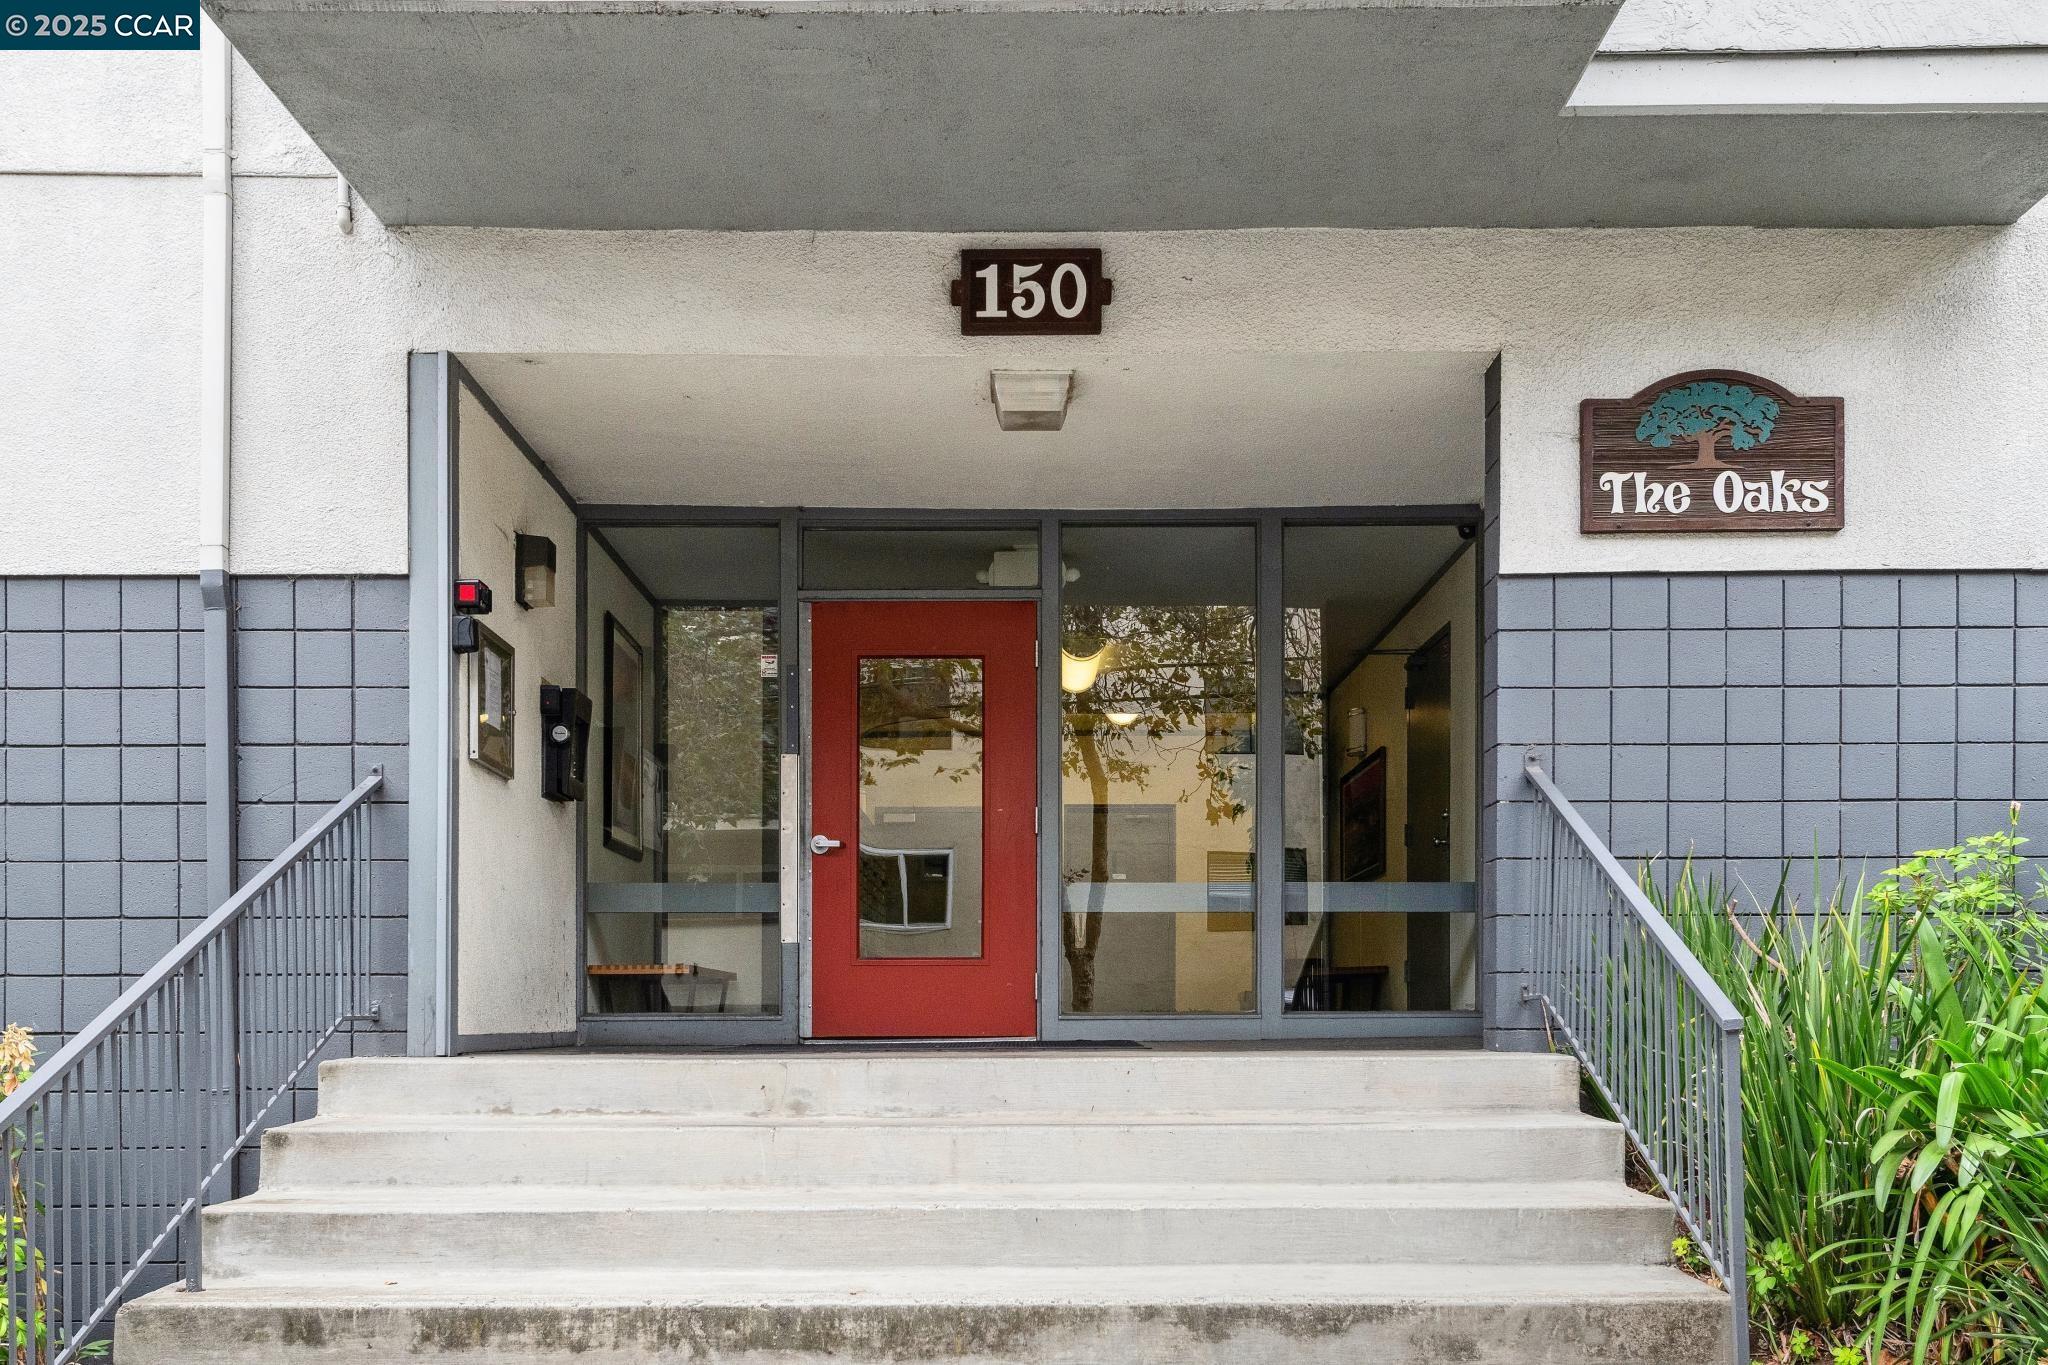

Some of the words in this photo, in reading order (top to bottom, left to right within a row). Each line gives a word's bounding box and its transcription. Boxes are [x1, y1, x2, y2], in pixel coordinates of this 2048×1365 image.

[975, 262, 1087, 319] 150
[1599, 471, 1691, 514] The
[1712, 469, 1829, 513] Oaks
